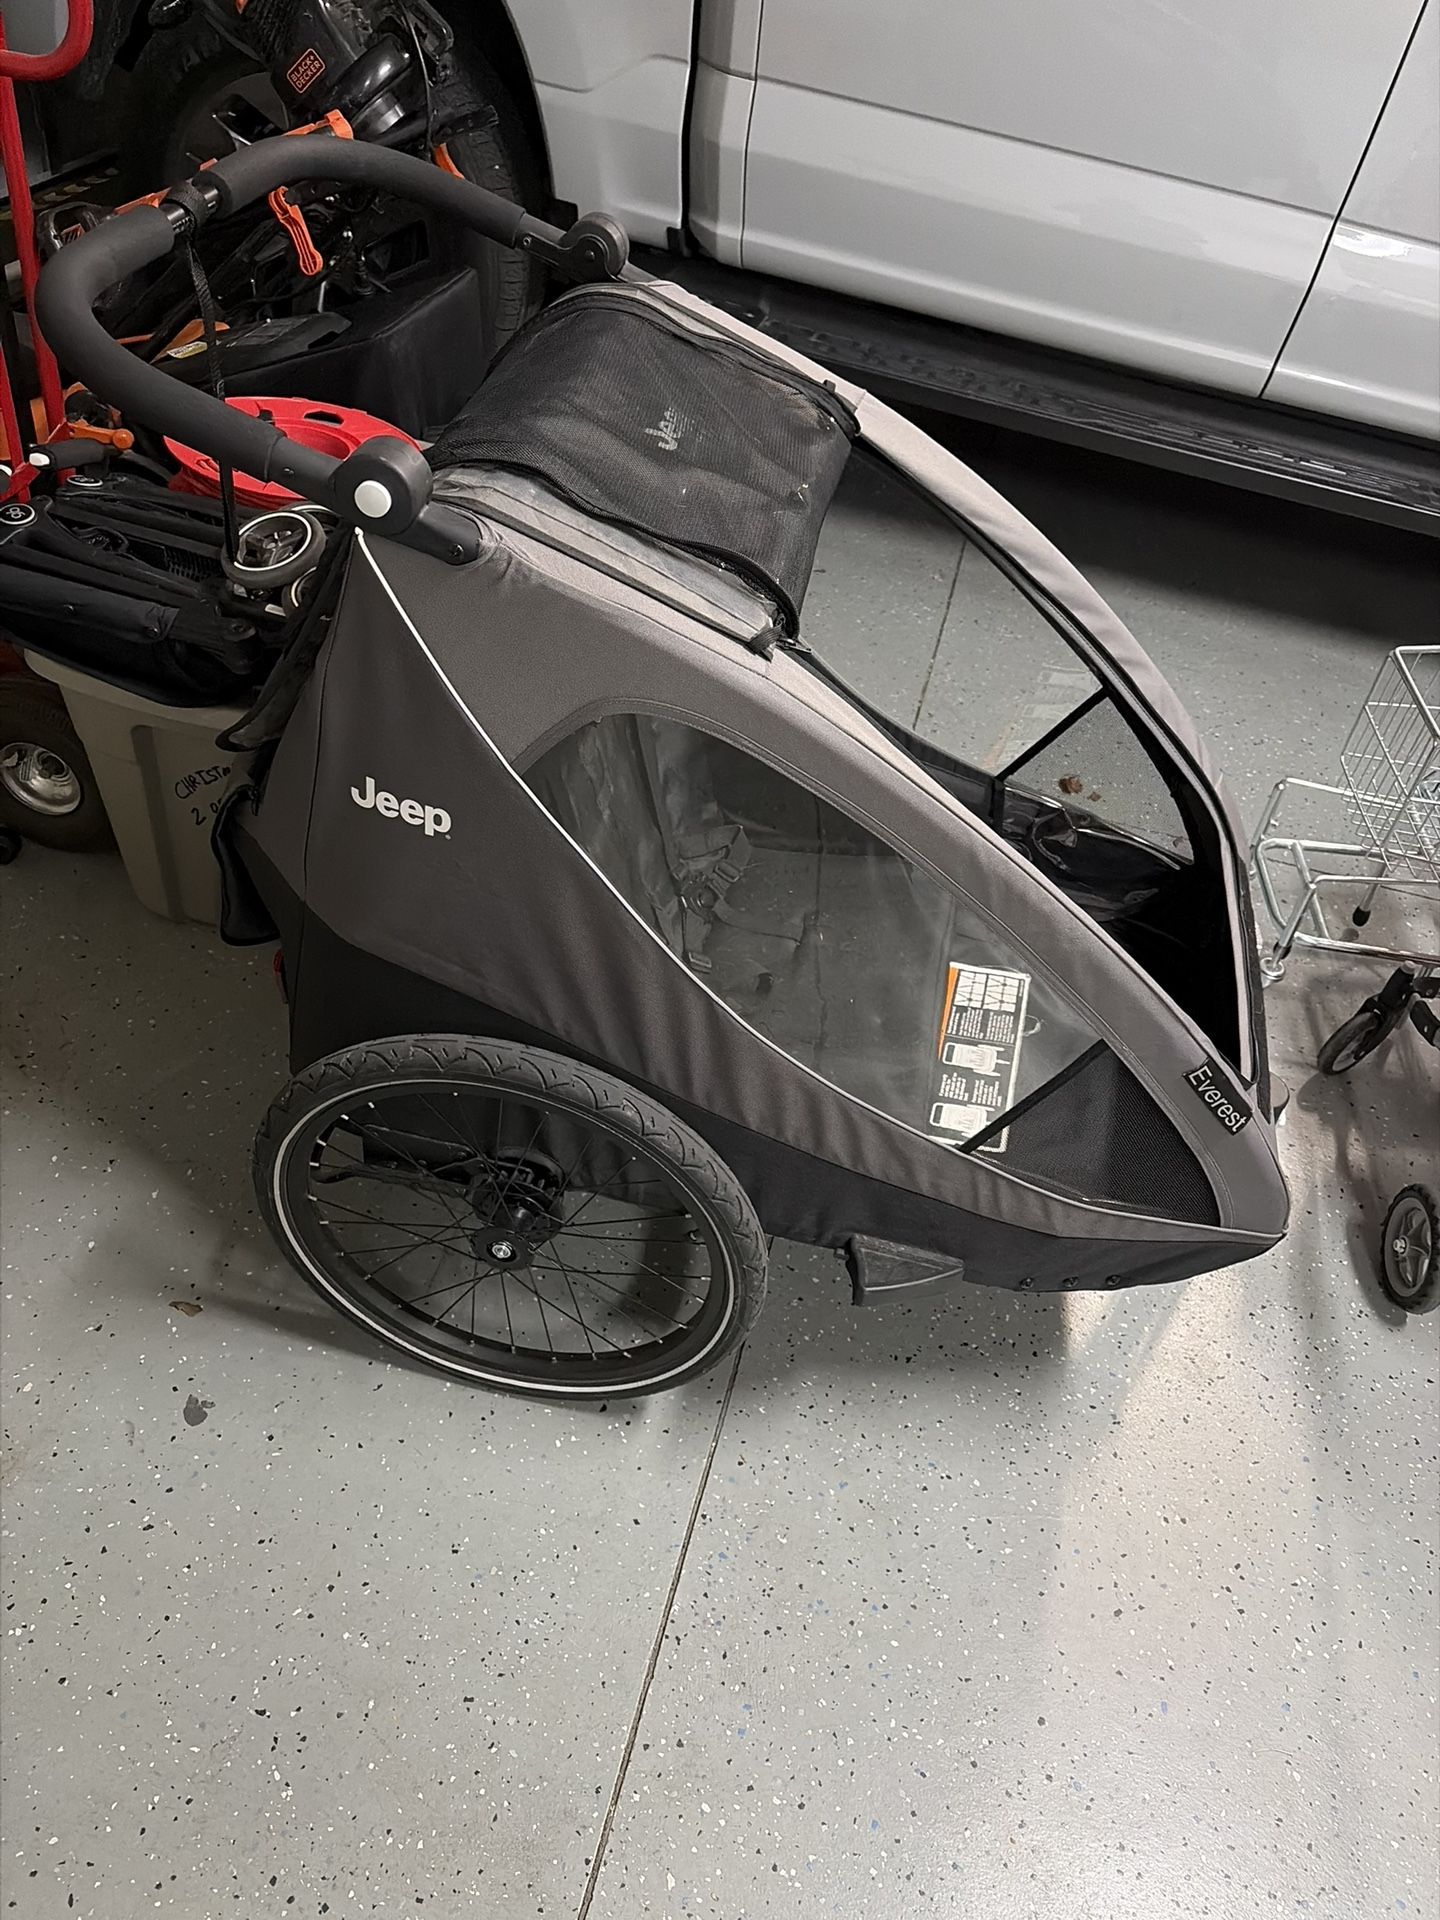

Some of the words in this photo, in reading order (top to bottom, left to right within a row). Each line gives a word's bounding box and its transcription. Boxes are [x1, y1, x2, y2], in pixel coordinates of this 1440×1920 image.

[295, 60, 321, 88] DECKER
[350, 776, 452, 837] Jeep
[1188, 1065, 1247, 1133] Everest
